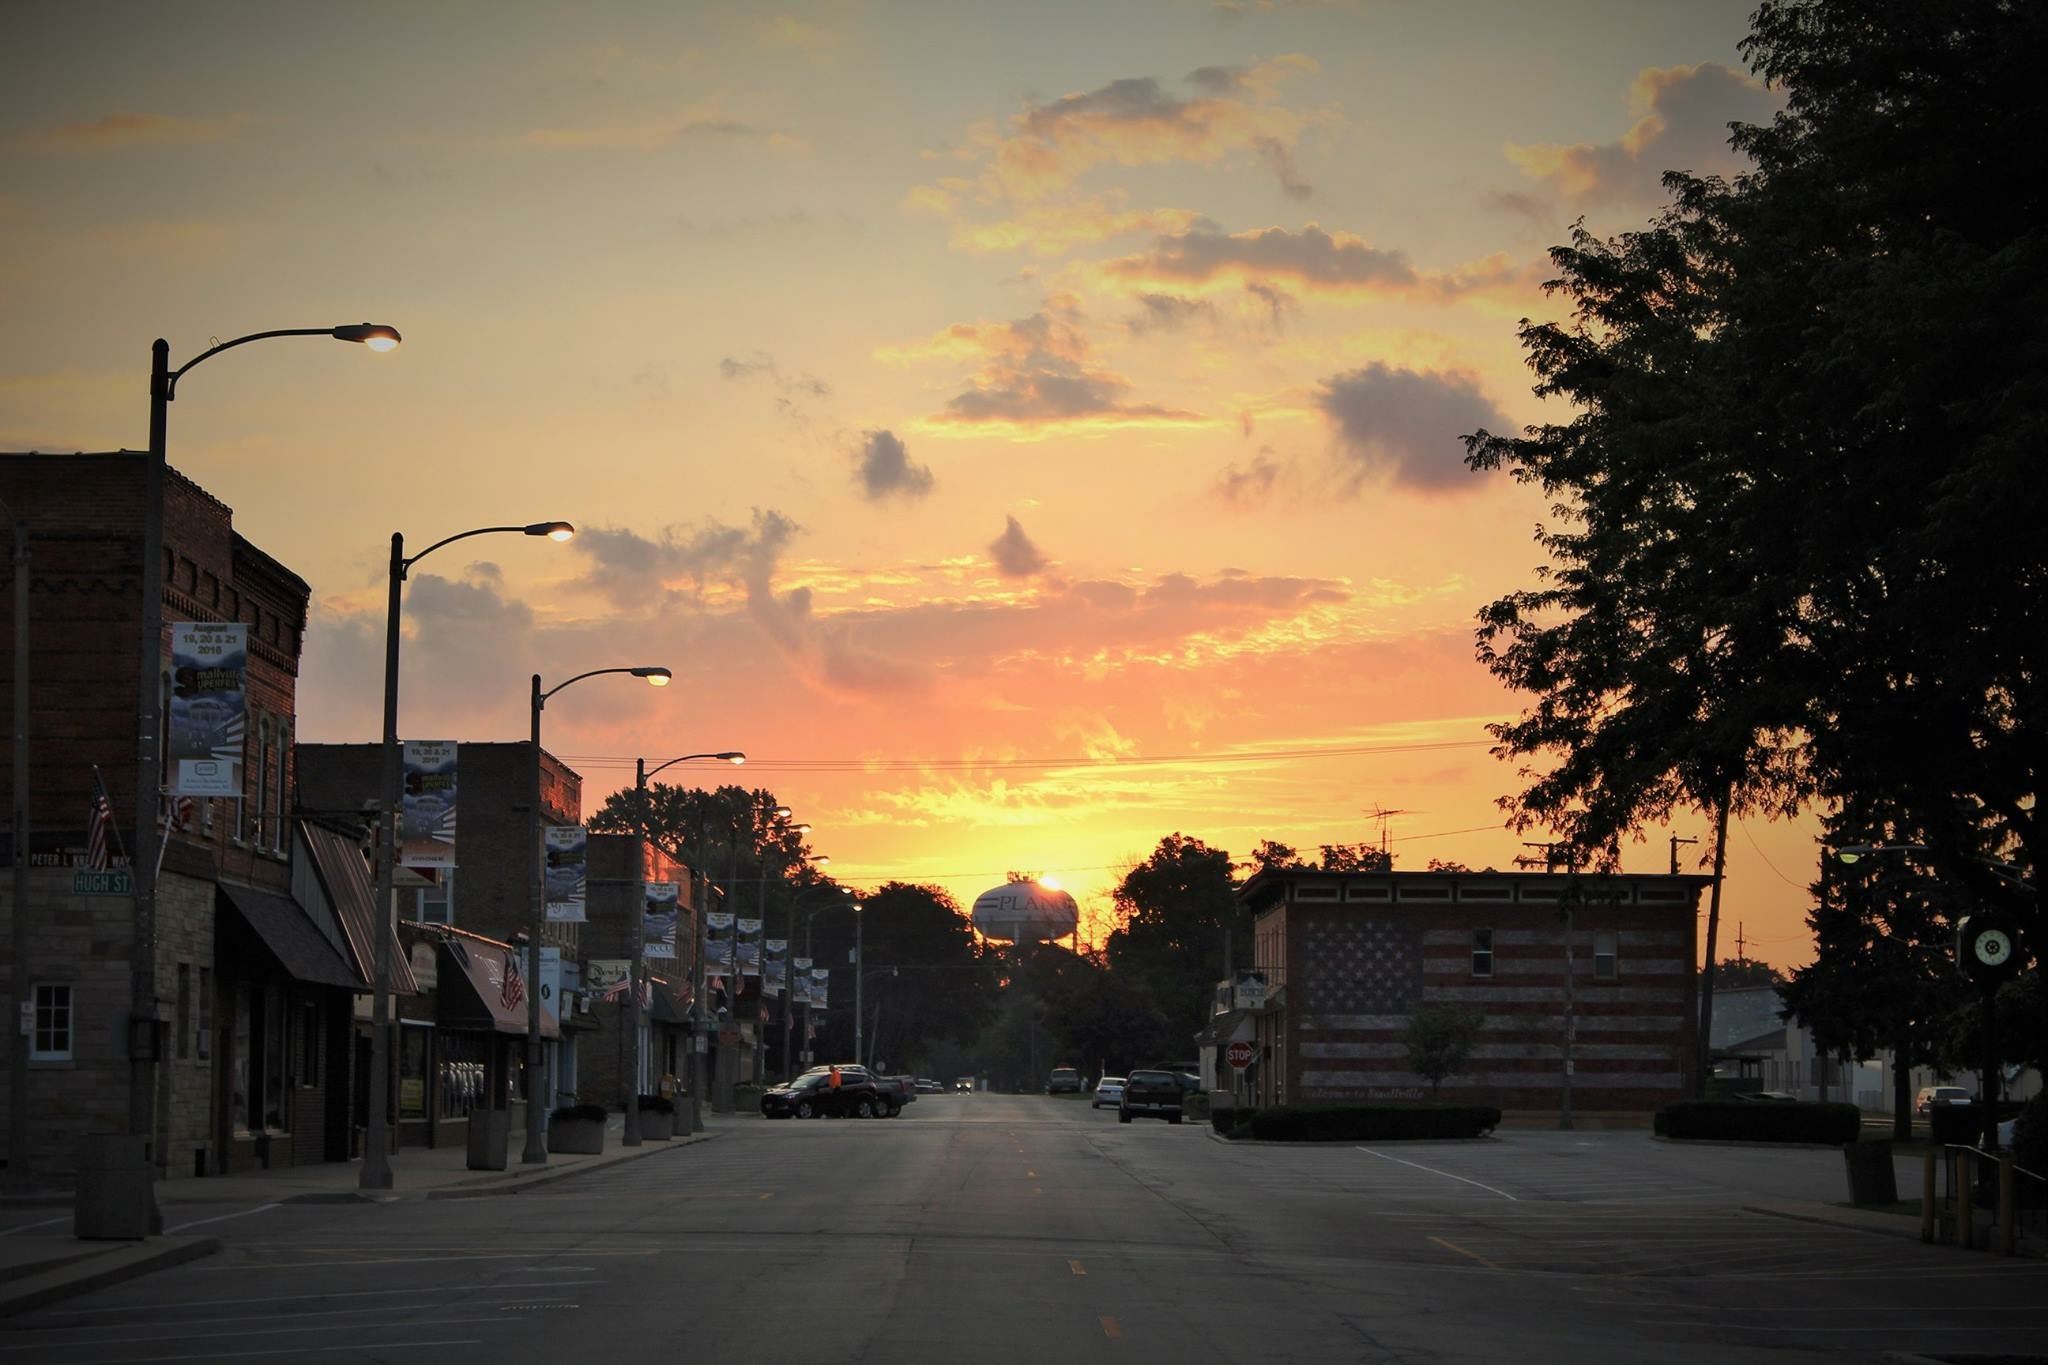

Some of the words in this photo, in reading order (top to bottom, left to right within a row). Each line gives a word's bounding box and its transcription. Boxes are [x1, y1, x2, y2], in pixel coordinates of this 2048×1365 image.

[192, 624, 228, 634] August
[200, 634, 213, 643] 20
[225, 634, 237, 644] 21
[31, 853, 60, 866] PETER
[75, 875, 109, 891] HUGH
[113, 875, 130, 893] ST
[1227, 1049, 1251, 1060] STOP
